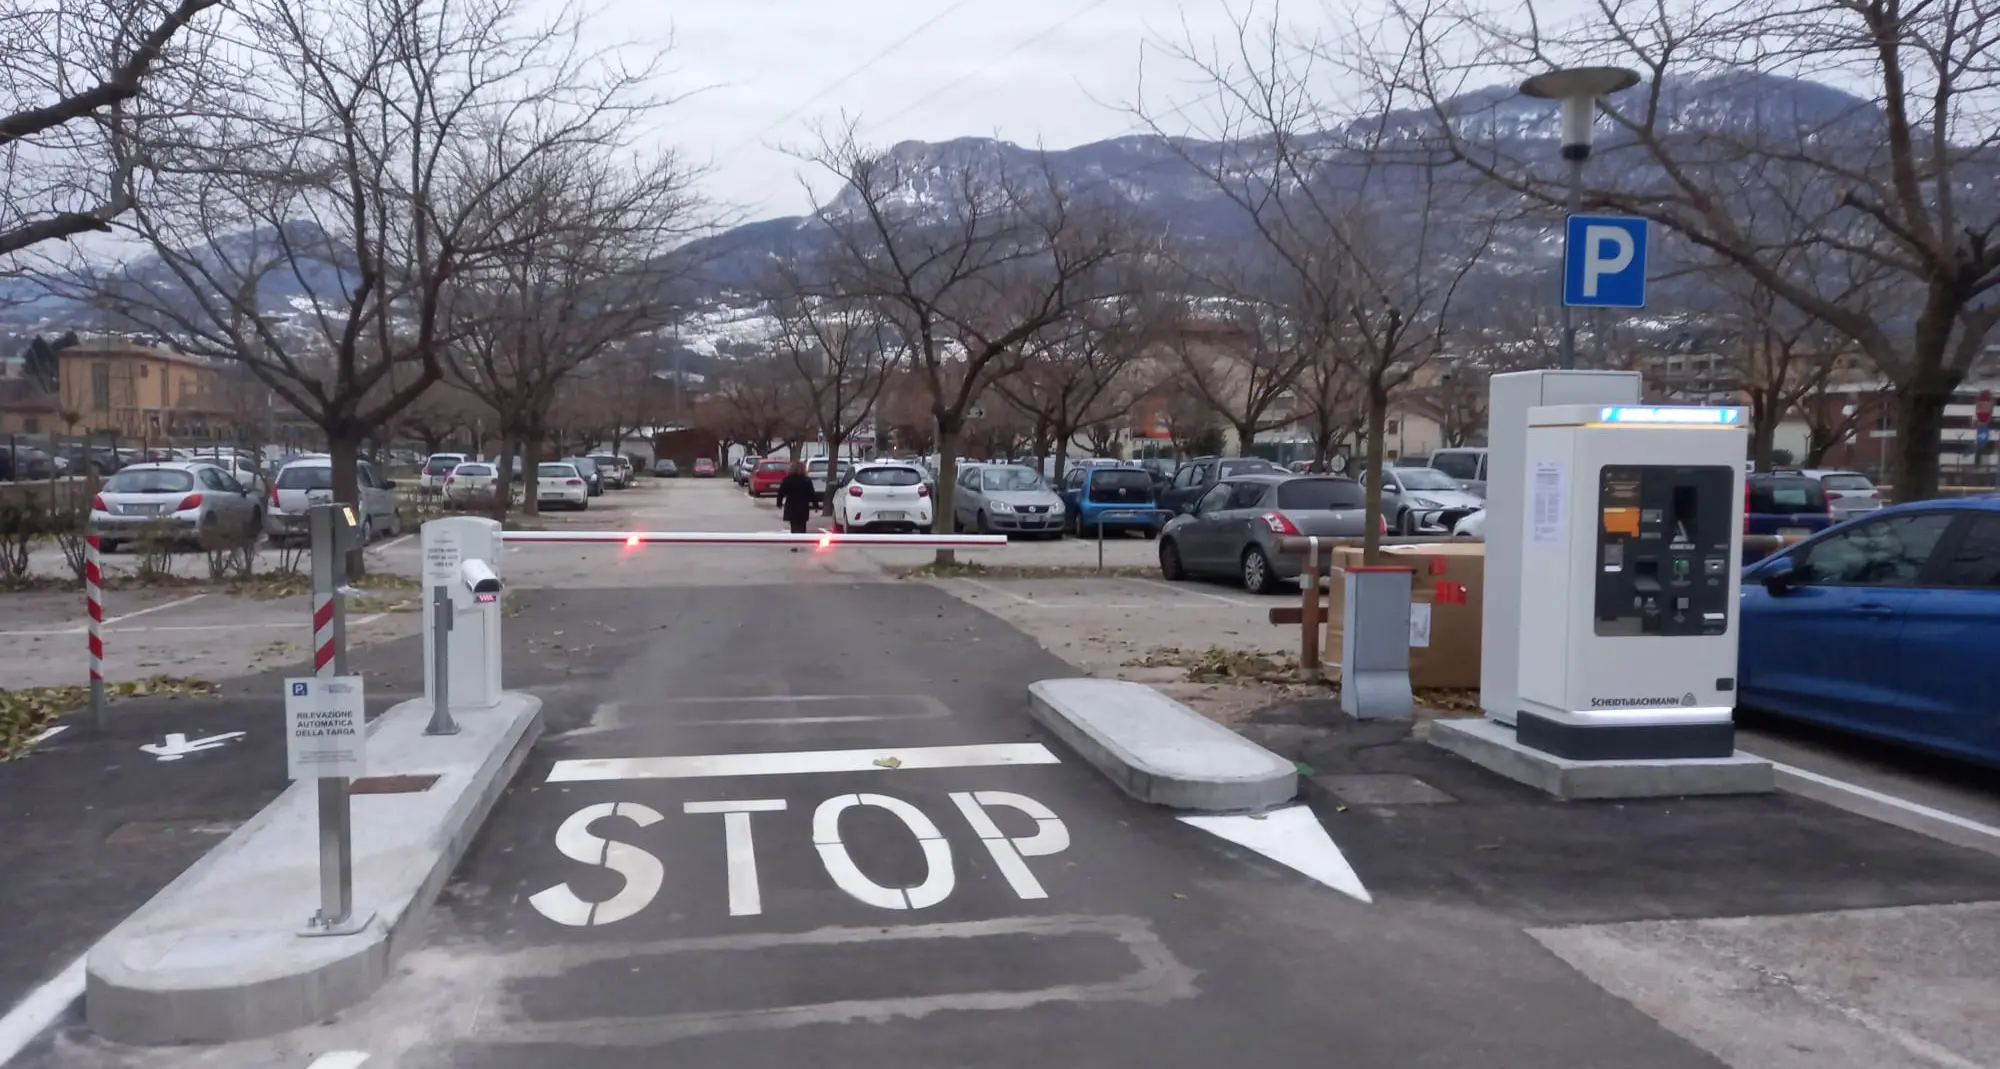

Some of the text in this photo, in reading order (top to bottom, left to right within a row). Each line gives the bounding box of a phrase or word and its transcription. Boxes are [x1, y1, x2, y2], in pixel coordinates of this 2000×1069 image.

[1583, 224, 1634, 297] P
[296, 710, 353, 720] RILEVAZIONE
[296, 719, 353, 728] AUTOMATICA
[295, 728, 355, 737] DELLA TARGA
[528, 791, 1070, 926] STOP
